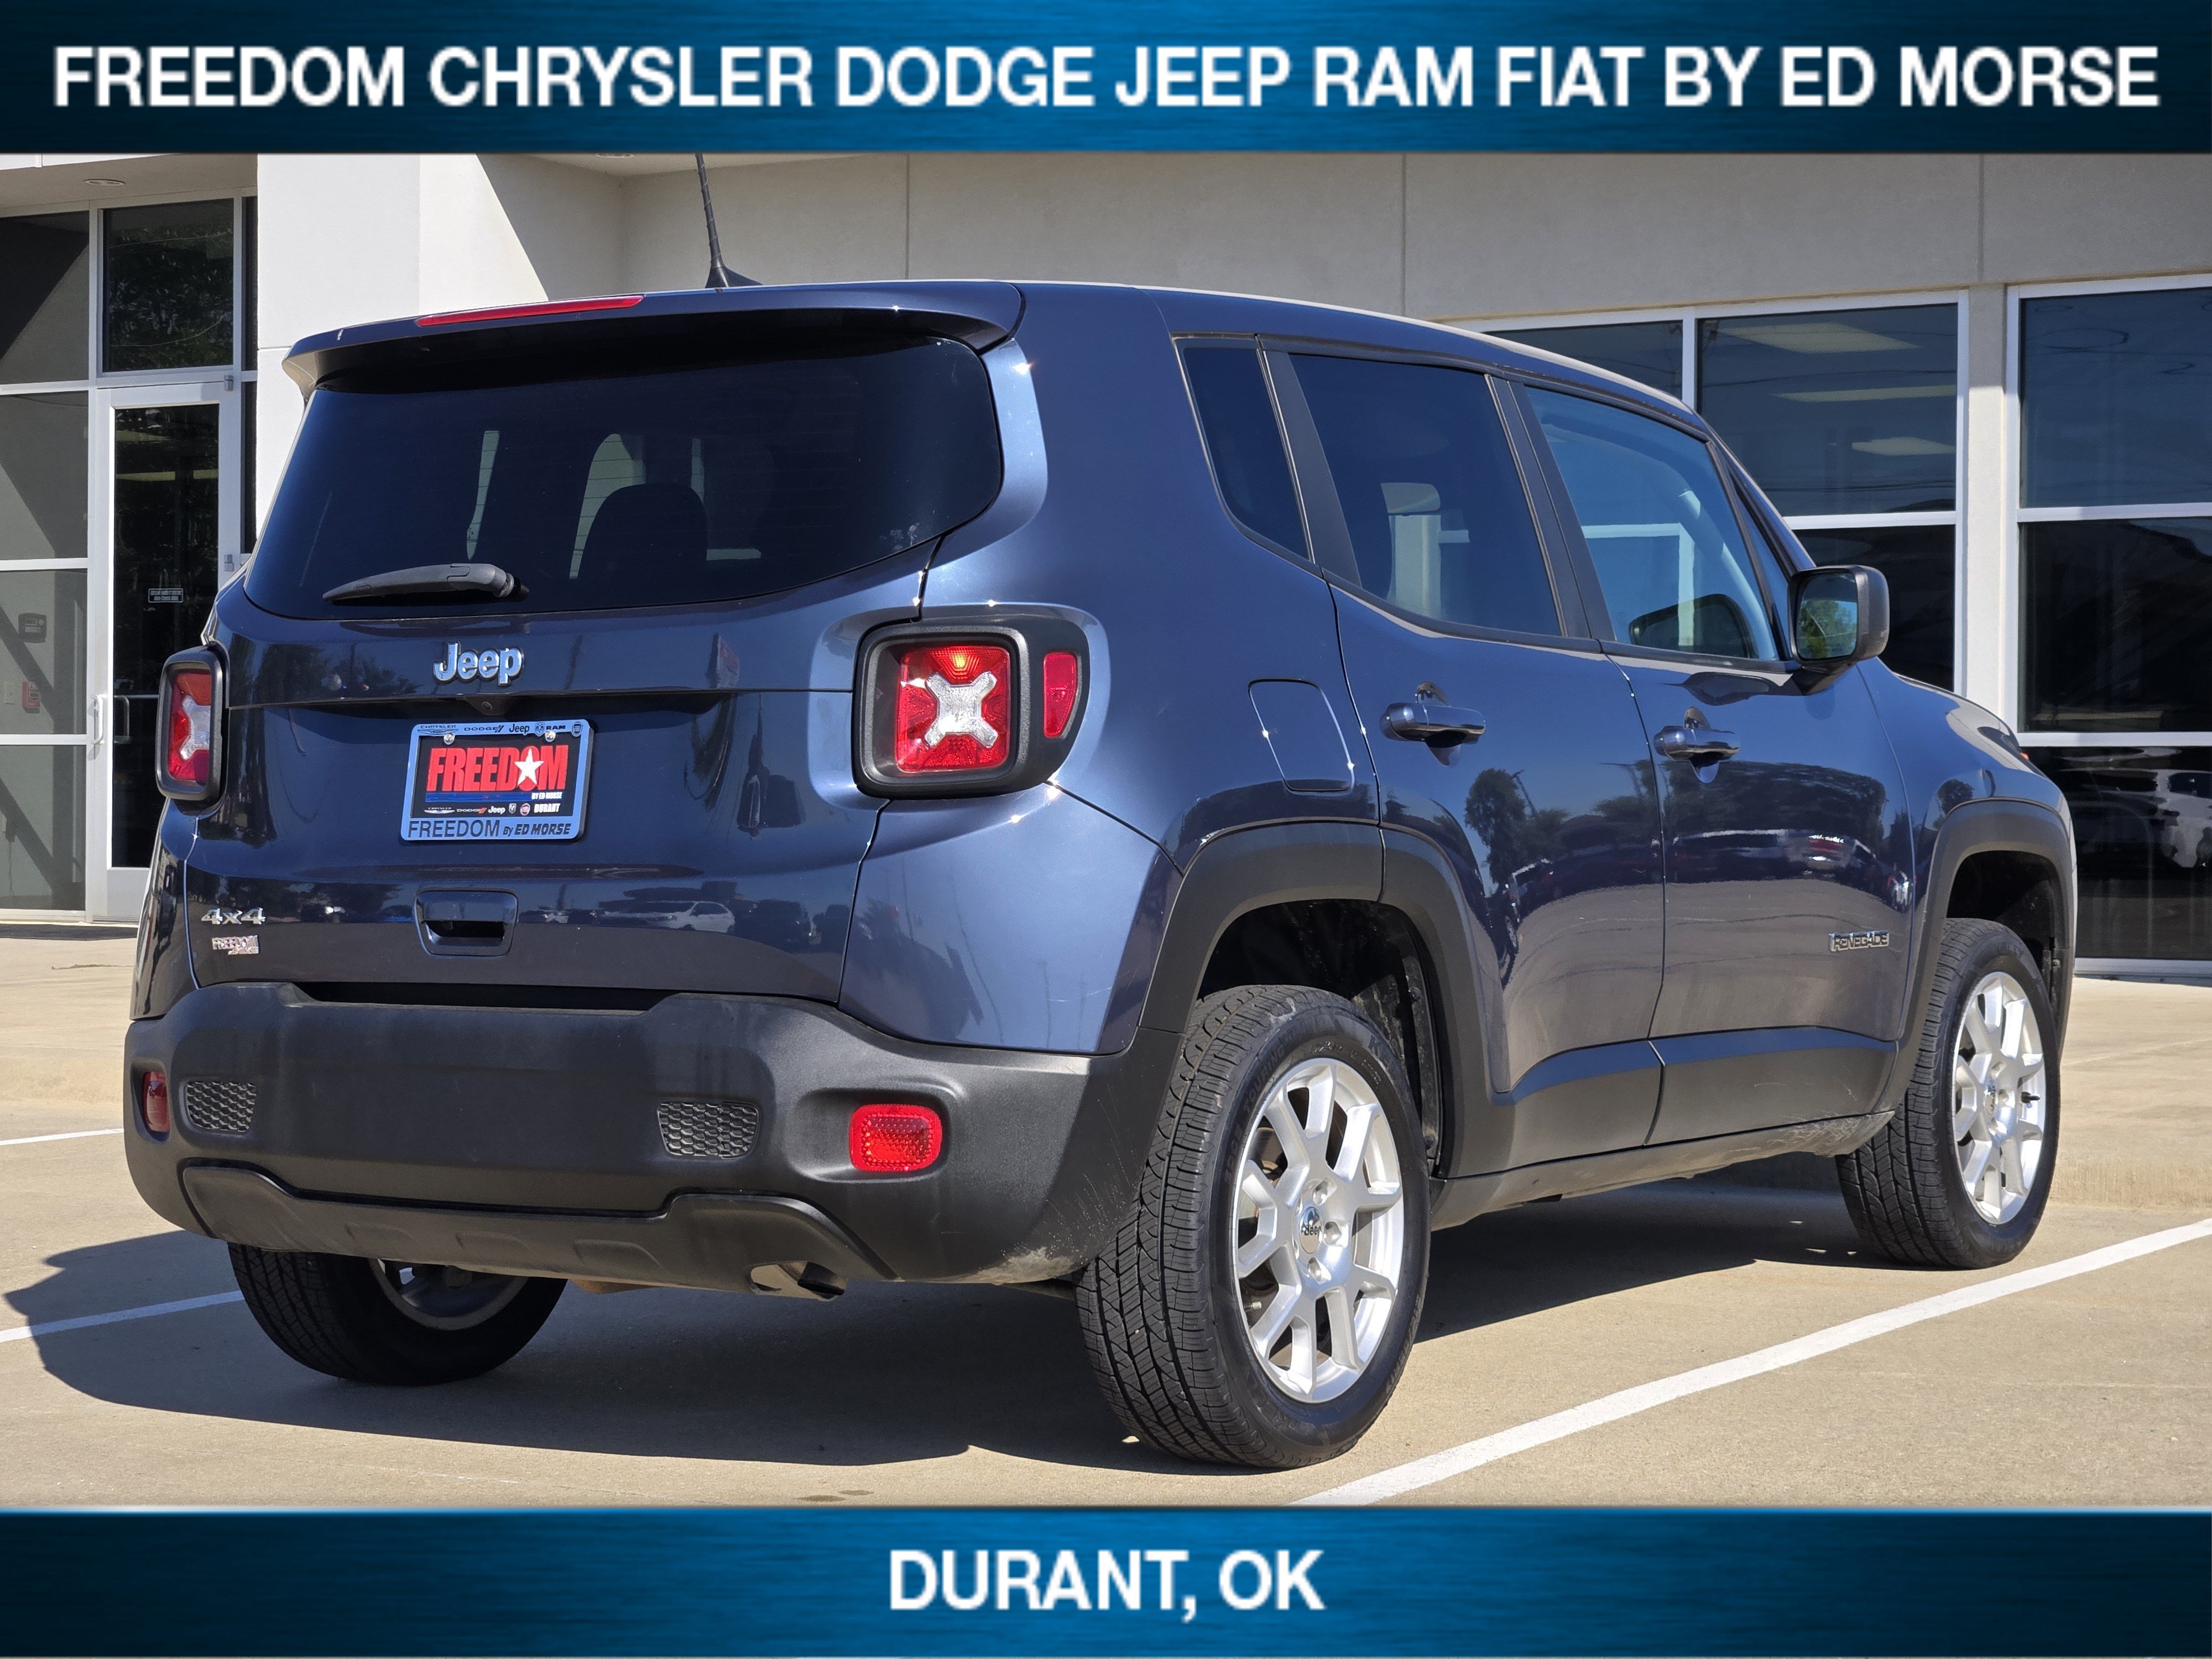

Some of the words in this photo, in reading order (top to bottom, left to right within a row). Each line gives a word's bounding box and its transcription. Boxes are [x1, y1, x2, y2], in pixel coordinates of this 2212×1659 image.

[434, 643, 524, 686] Jeep
[509, 723, 530, 734] Jeep
[426, 745, 569, 792] FREEDOM
[488, 806, 505, 815] Jeep
[534, 803, 561, 813] DURANT
[408, 820, 500, 838] FREEDOM
[514, 823, 529, 835] ED
[530, 823, 571, 835] MORSE
[1829, 931, 1890, 952] RENEGADE
